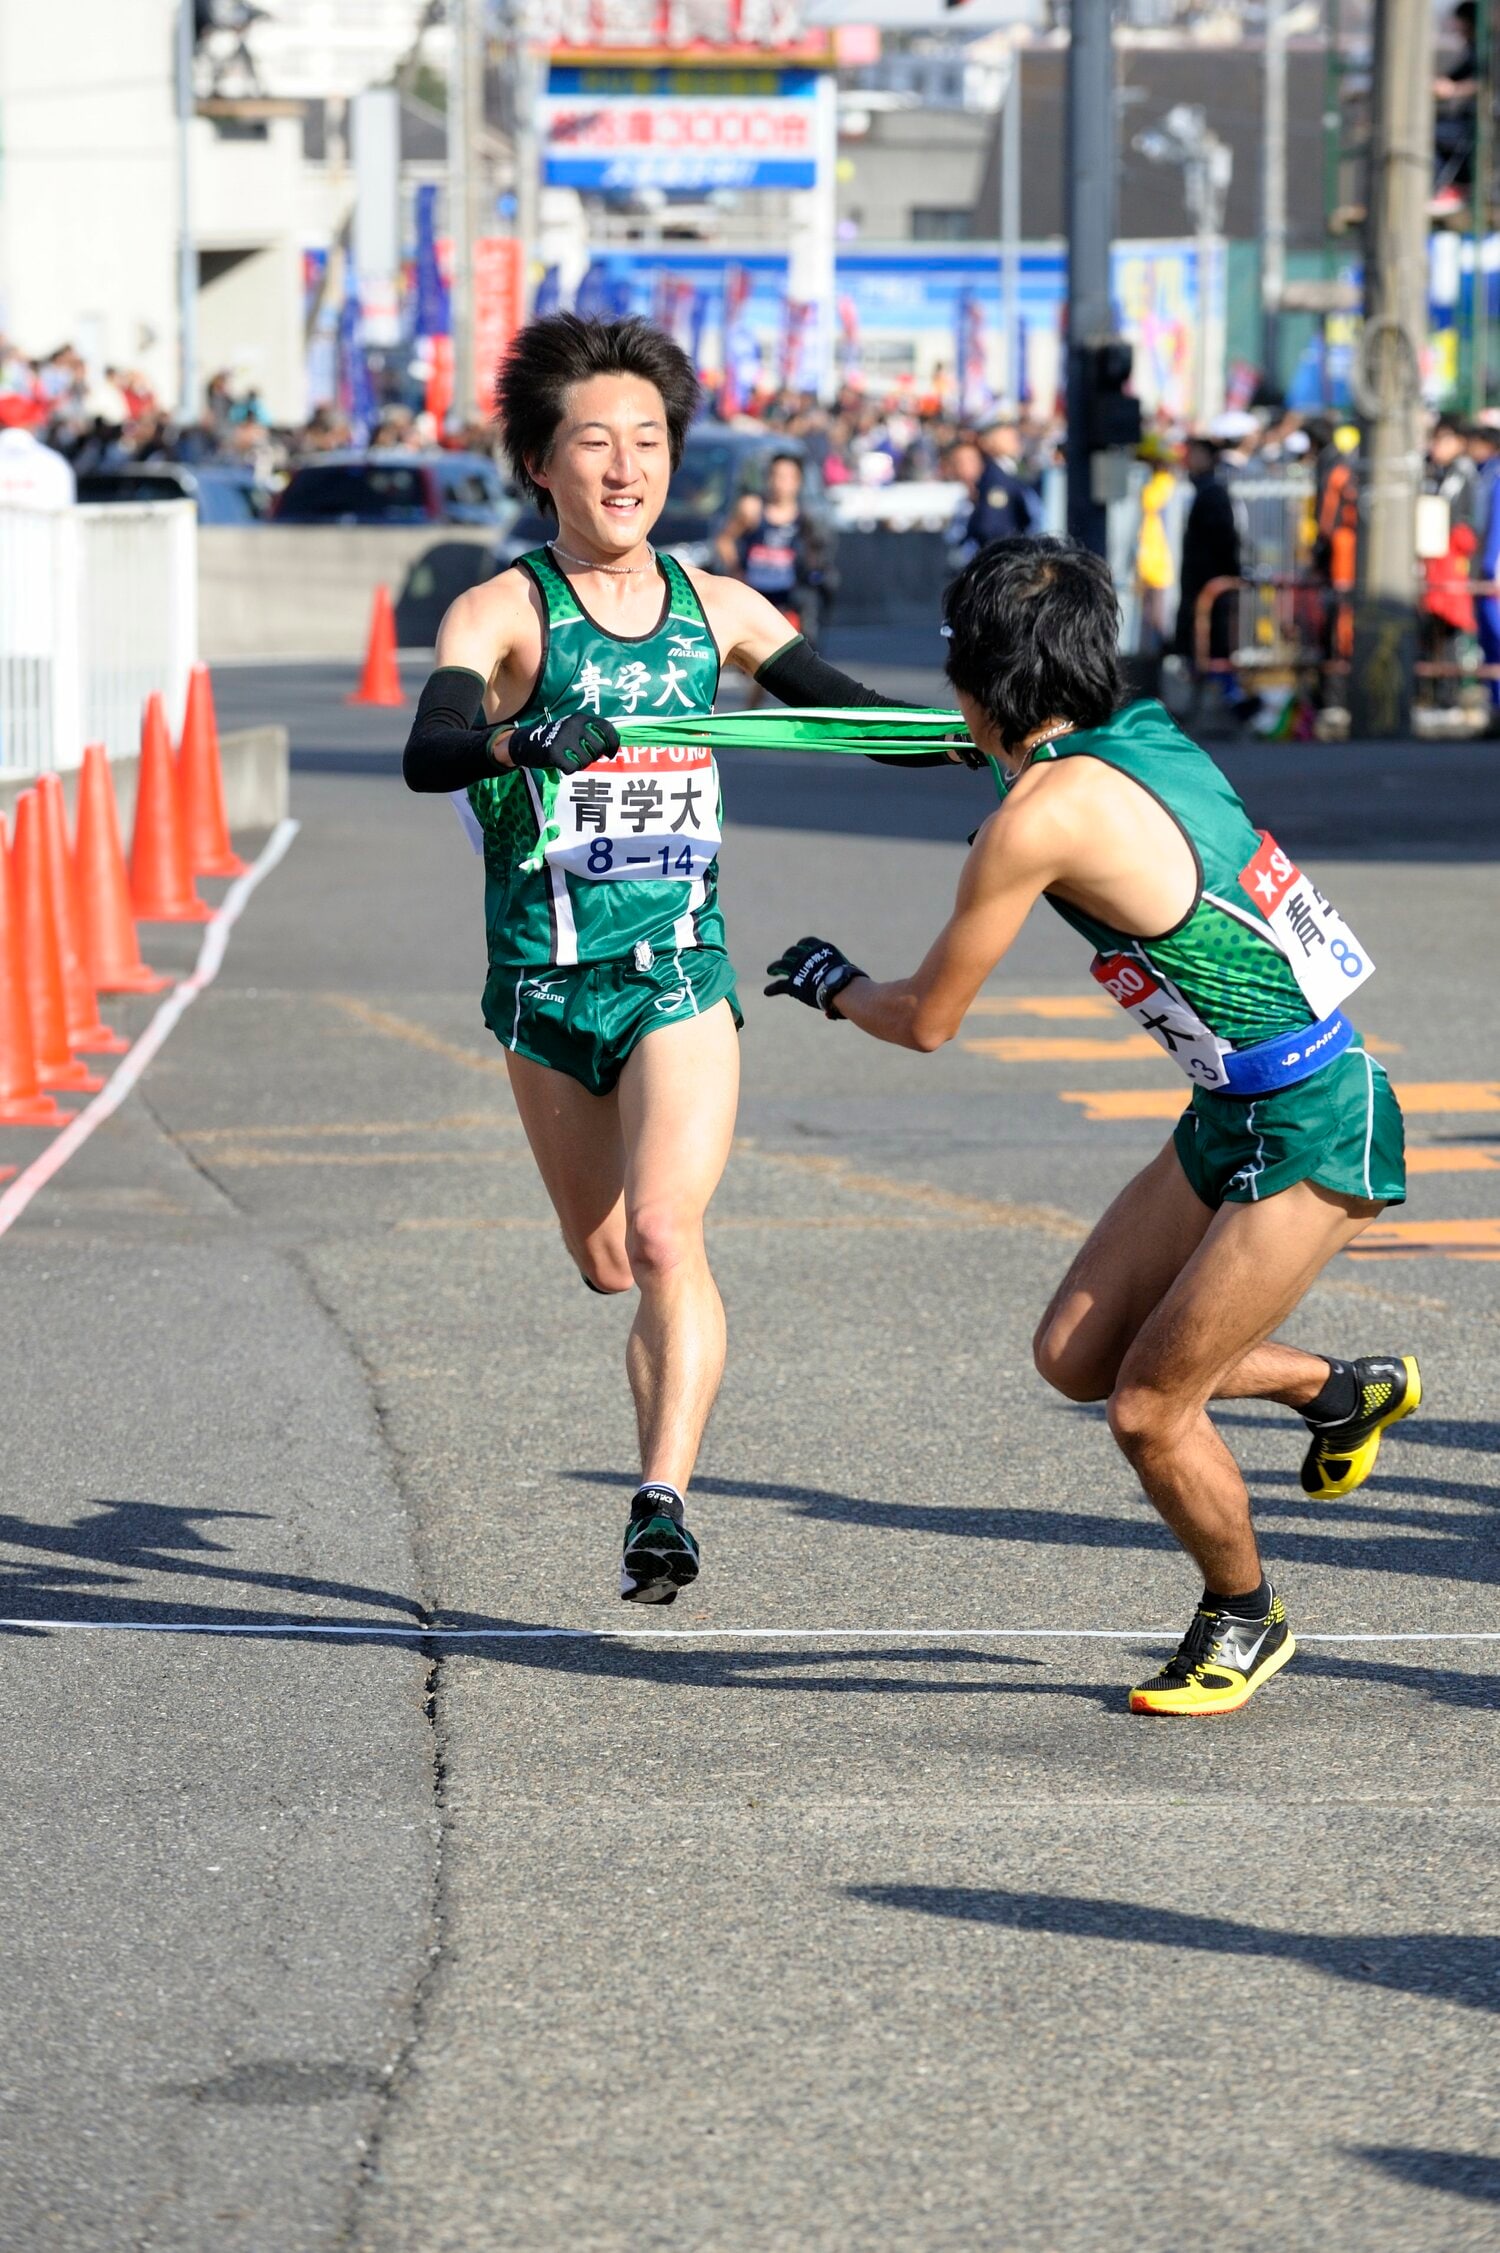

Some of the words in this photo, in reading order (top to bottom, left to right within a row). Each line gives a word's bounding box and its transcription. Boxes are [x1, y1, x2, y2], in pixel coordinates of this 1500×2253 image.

[571, 659, 696, 715] 青学大
[569, 777, 702, 833] 青学大
[1286, 888, 1344, 958] 青
[1139, 1008, 1196, 1052] 大
